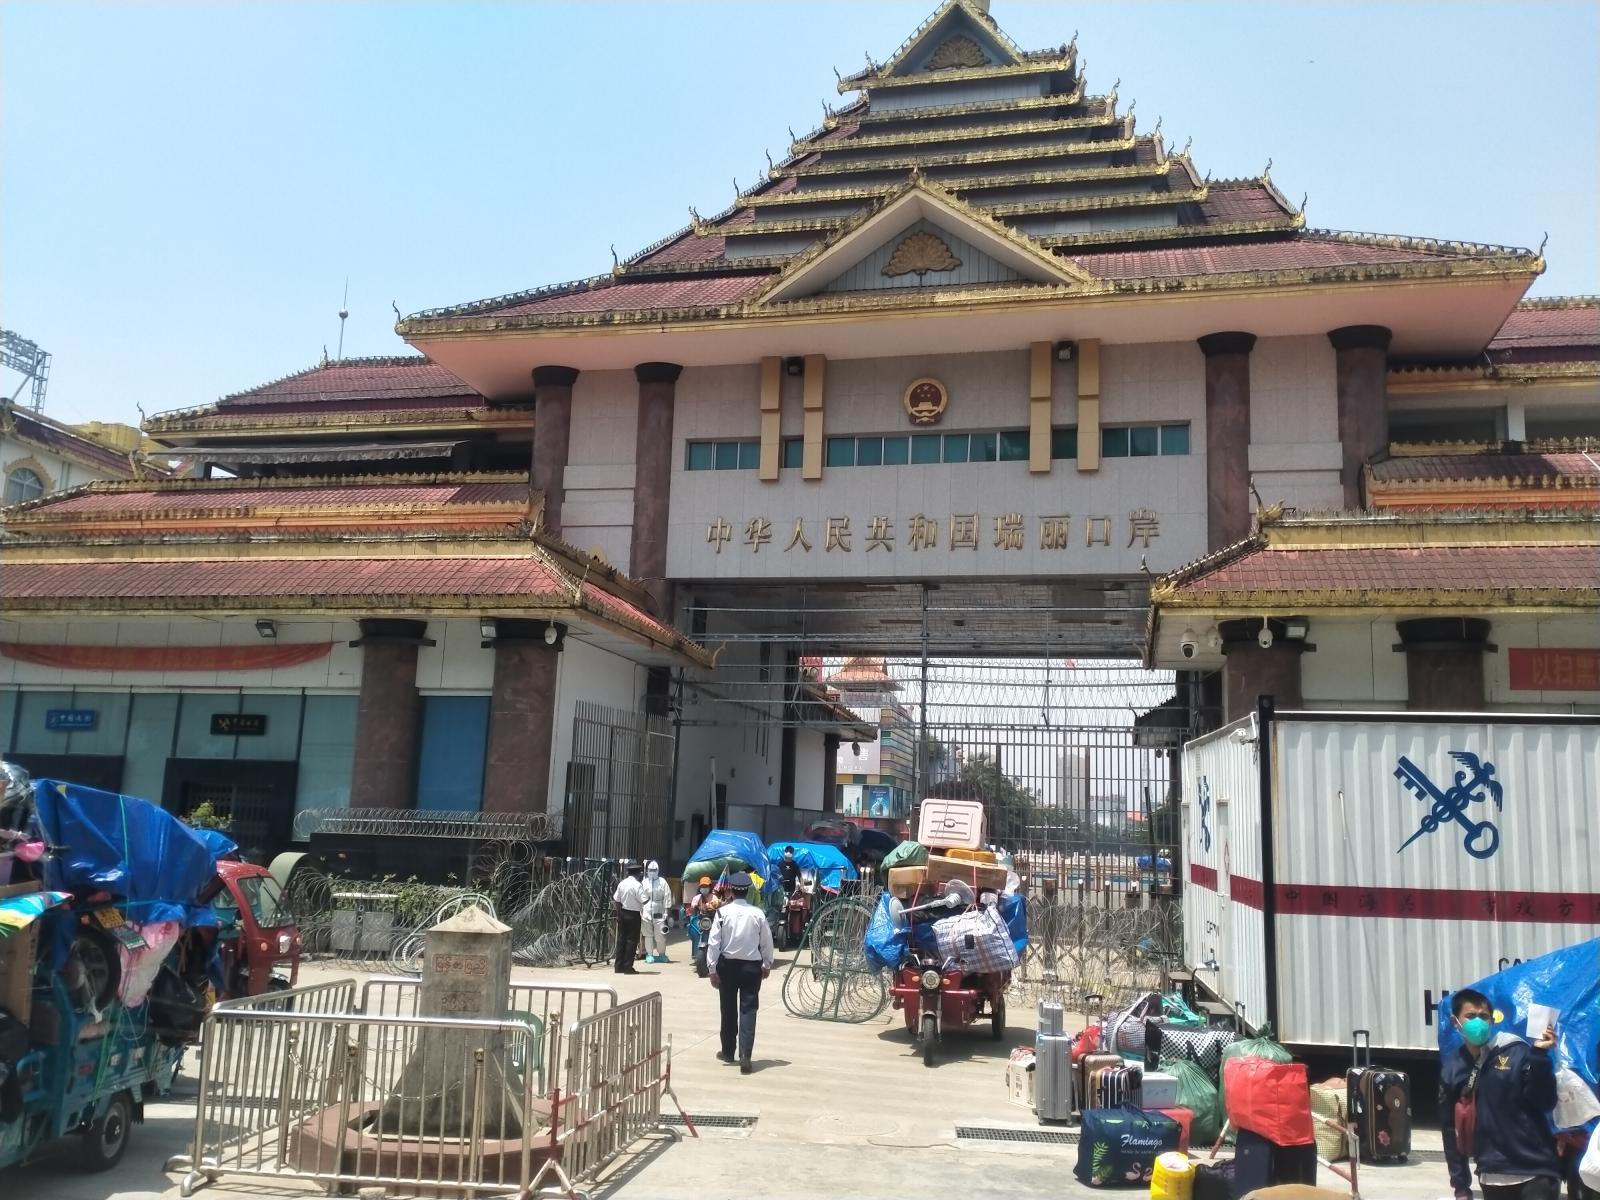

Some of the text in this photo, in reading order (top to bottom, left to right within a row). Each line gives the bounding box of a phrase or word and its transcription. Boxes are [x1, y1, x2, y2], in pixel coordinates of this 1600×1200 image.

[706, 508, 1161, 553] 中华人民共和国瑞丽口岸
[1120, 1134, 1163, 1149] Flamingo
